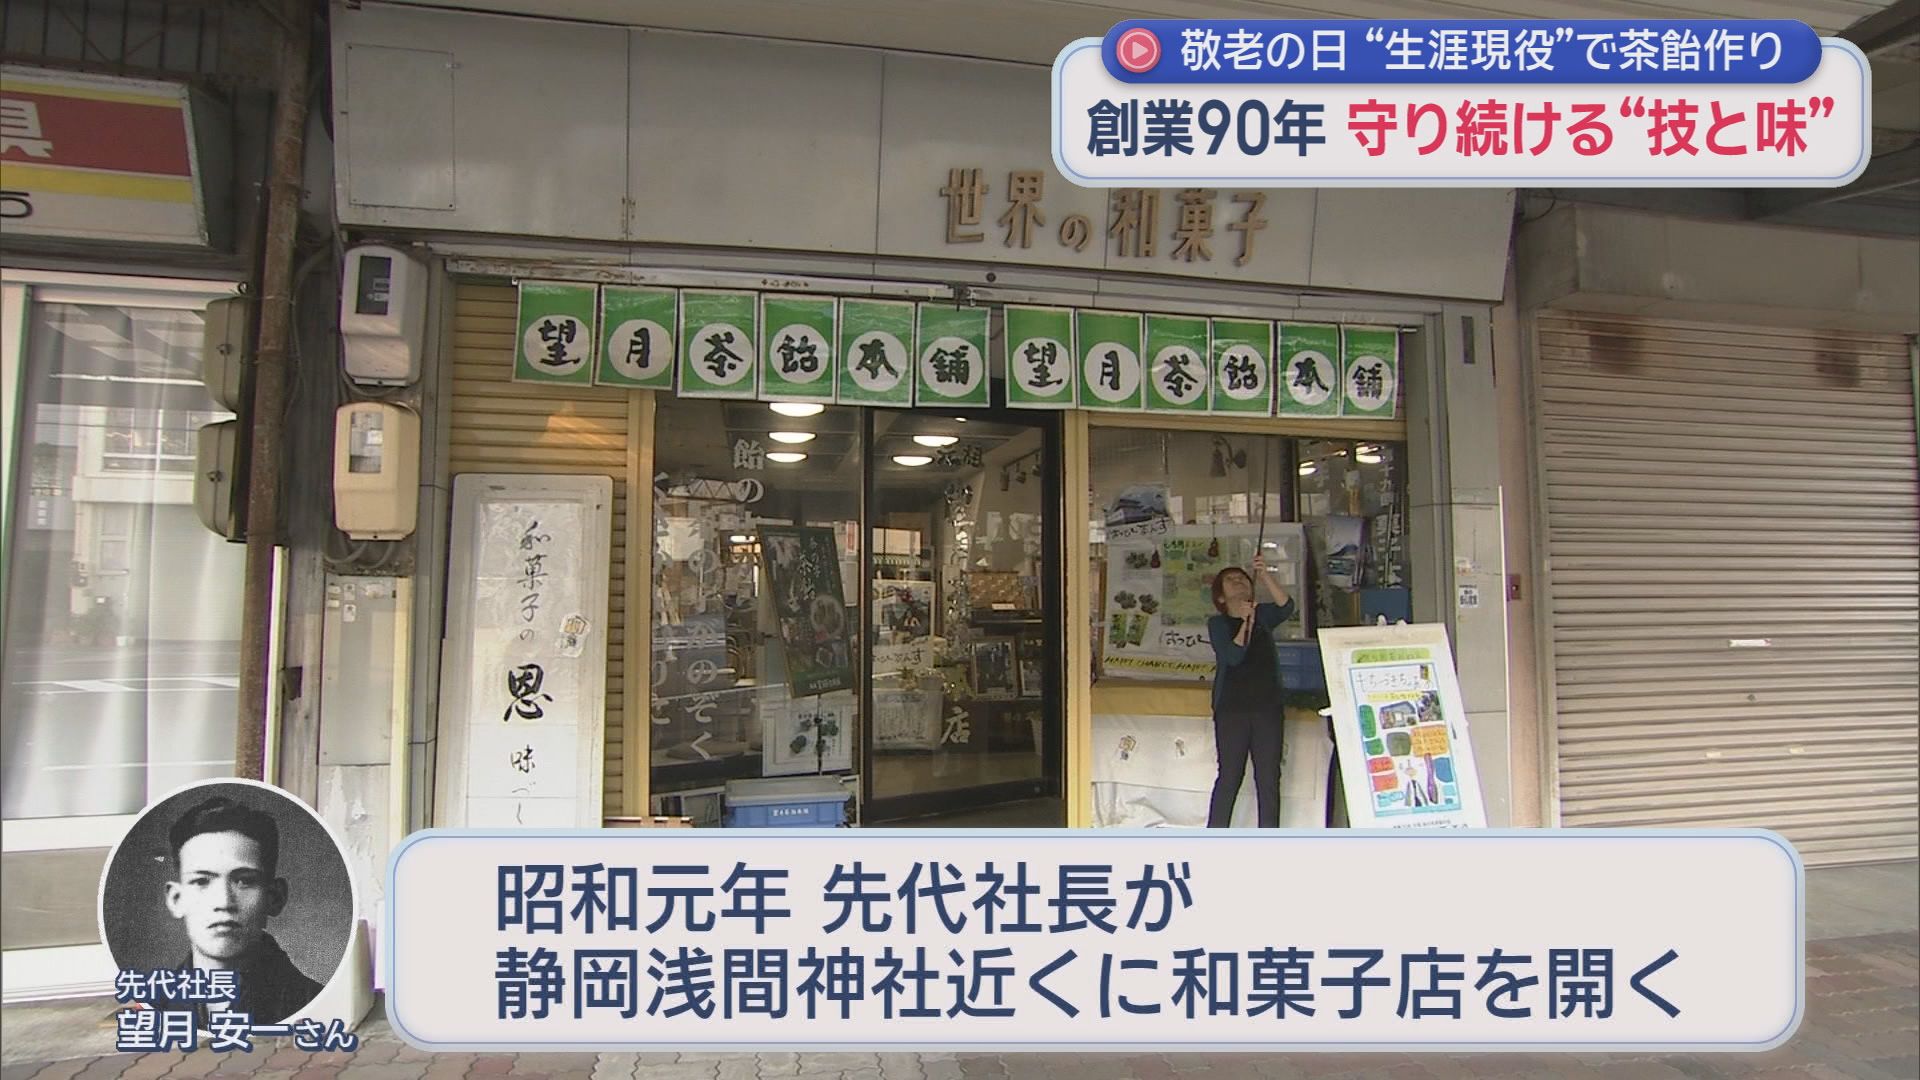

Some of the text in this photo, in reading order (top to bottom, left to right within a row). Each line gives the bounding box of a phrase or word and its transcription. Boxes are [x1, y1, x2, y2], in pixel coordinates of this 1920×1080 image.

[939, 166, 1271, 268] 世界の和菓子
